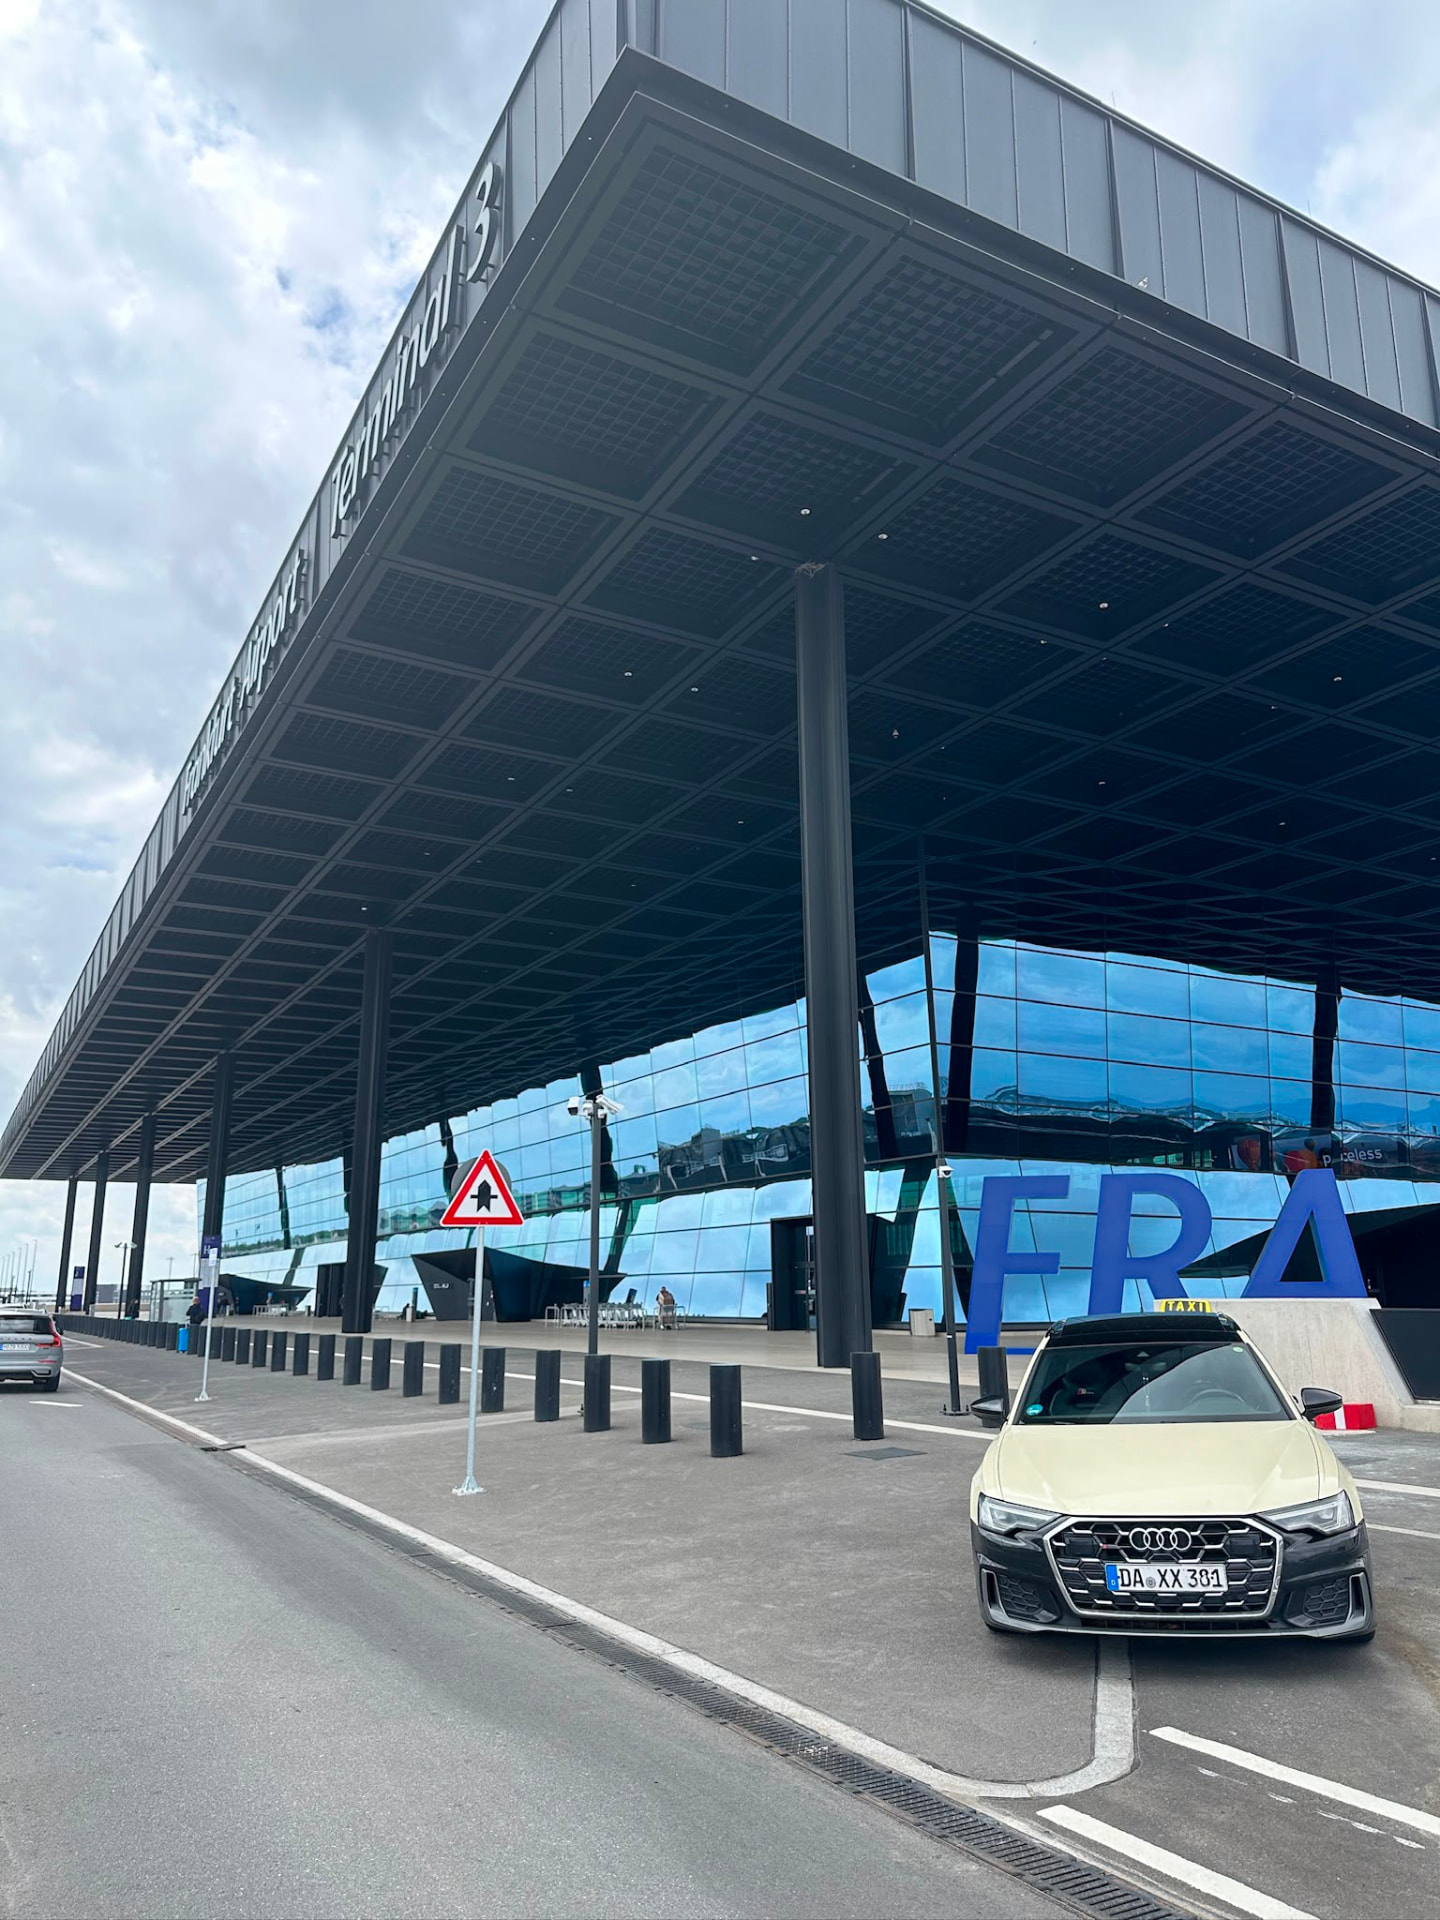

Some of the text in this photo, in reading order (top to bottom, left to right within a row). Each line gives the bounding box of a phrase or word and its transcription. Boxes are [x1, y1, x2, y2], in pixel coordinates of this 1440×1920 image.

[182, 161, 500, 815] Frankfurt Airport Terminal 3
[1322, 1148, 1383, 1167] piceless
[963, 1168, 1368, 1355] FRA
[1167, 1301, 1203, 1312] TAXI
[1118, 1568, 1145, 1588] DA
[1157, 1568, 1183, 1588] XX
[1187, 1568, 1224, 1588] 381
